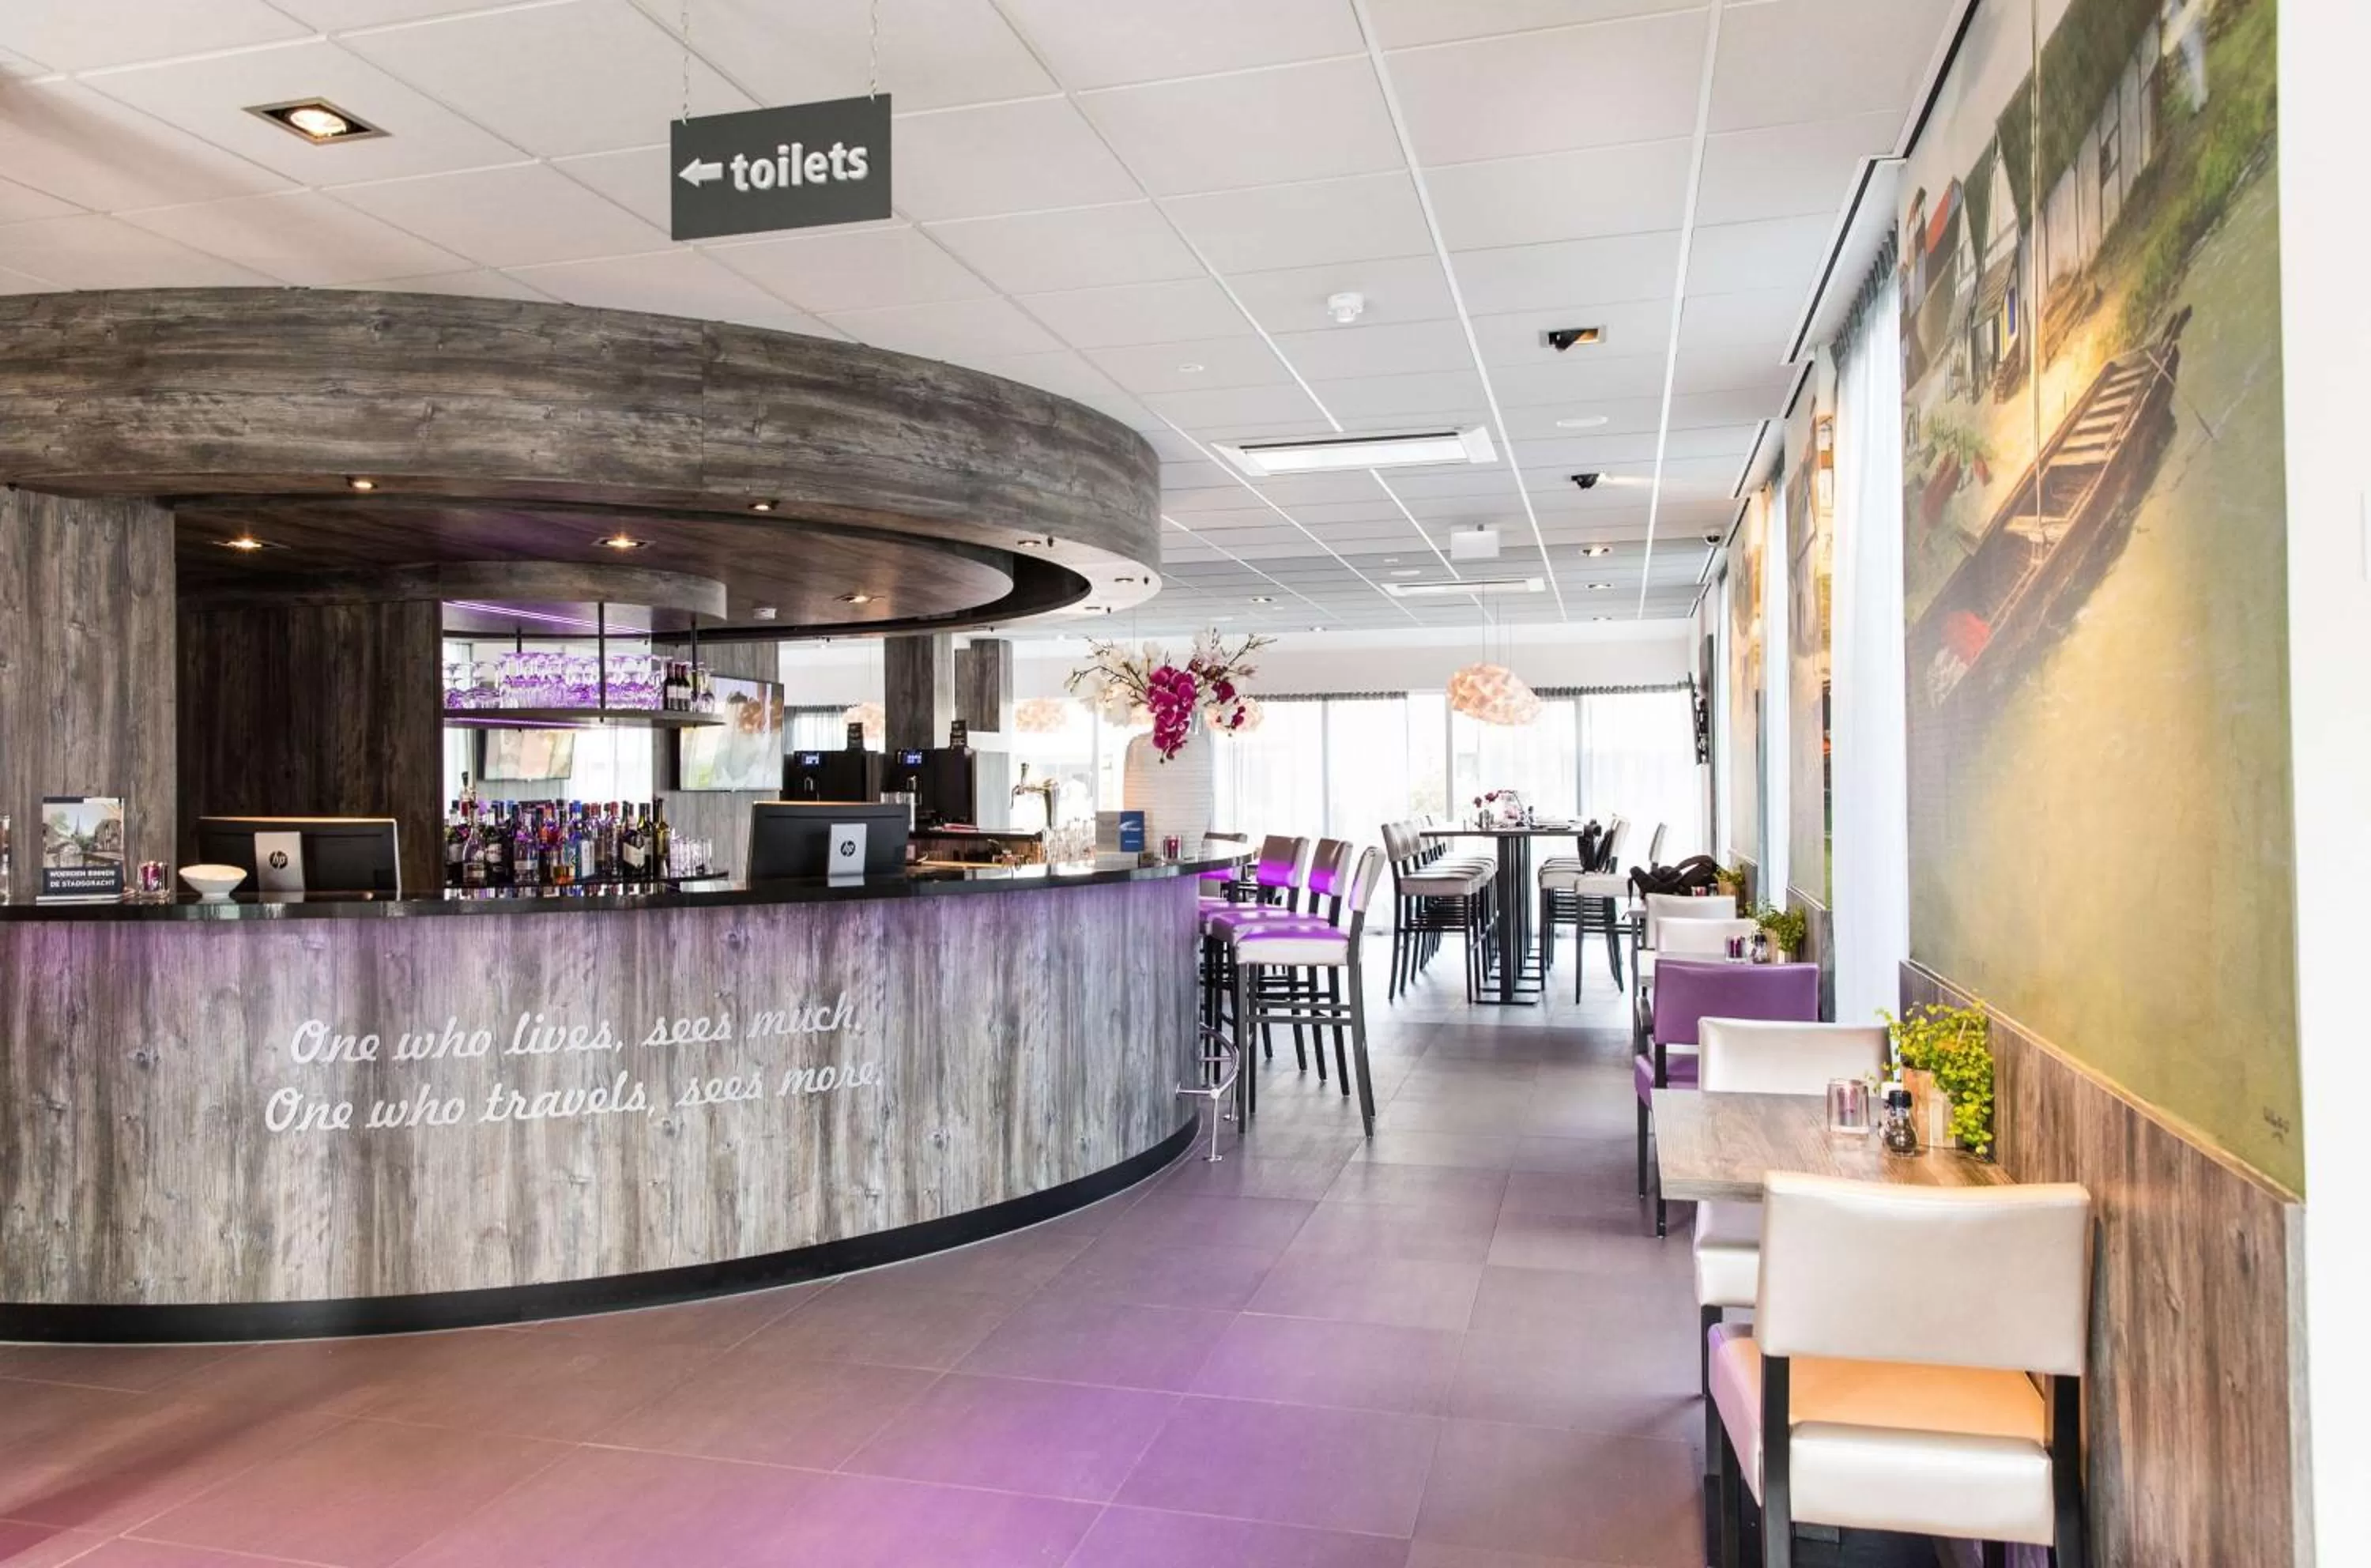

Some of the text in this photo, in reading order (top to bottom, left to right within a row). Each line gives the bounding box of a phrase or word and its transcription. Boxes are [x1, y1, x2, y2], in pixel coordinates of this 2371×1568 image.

[730, 141, 869, 192] toilets
[291, 991, 862, 1064] One who lives, sees much.
[265, 1061, 884, 1132] One who travels, sees more.
